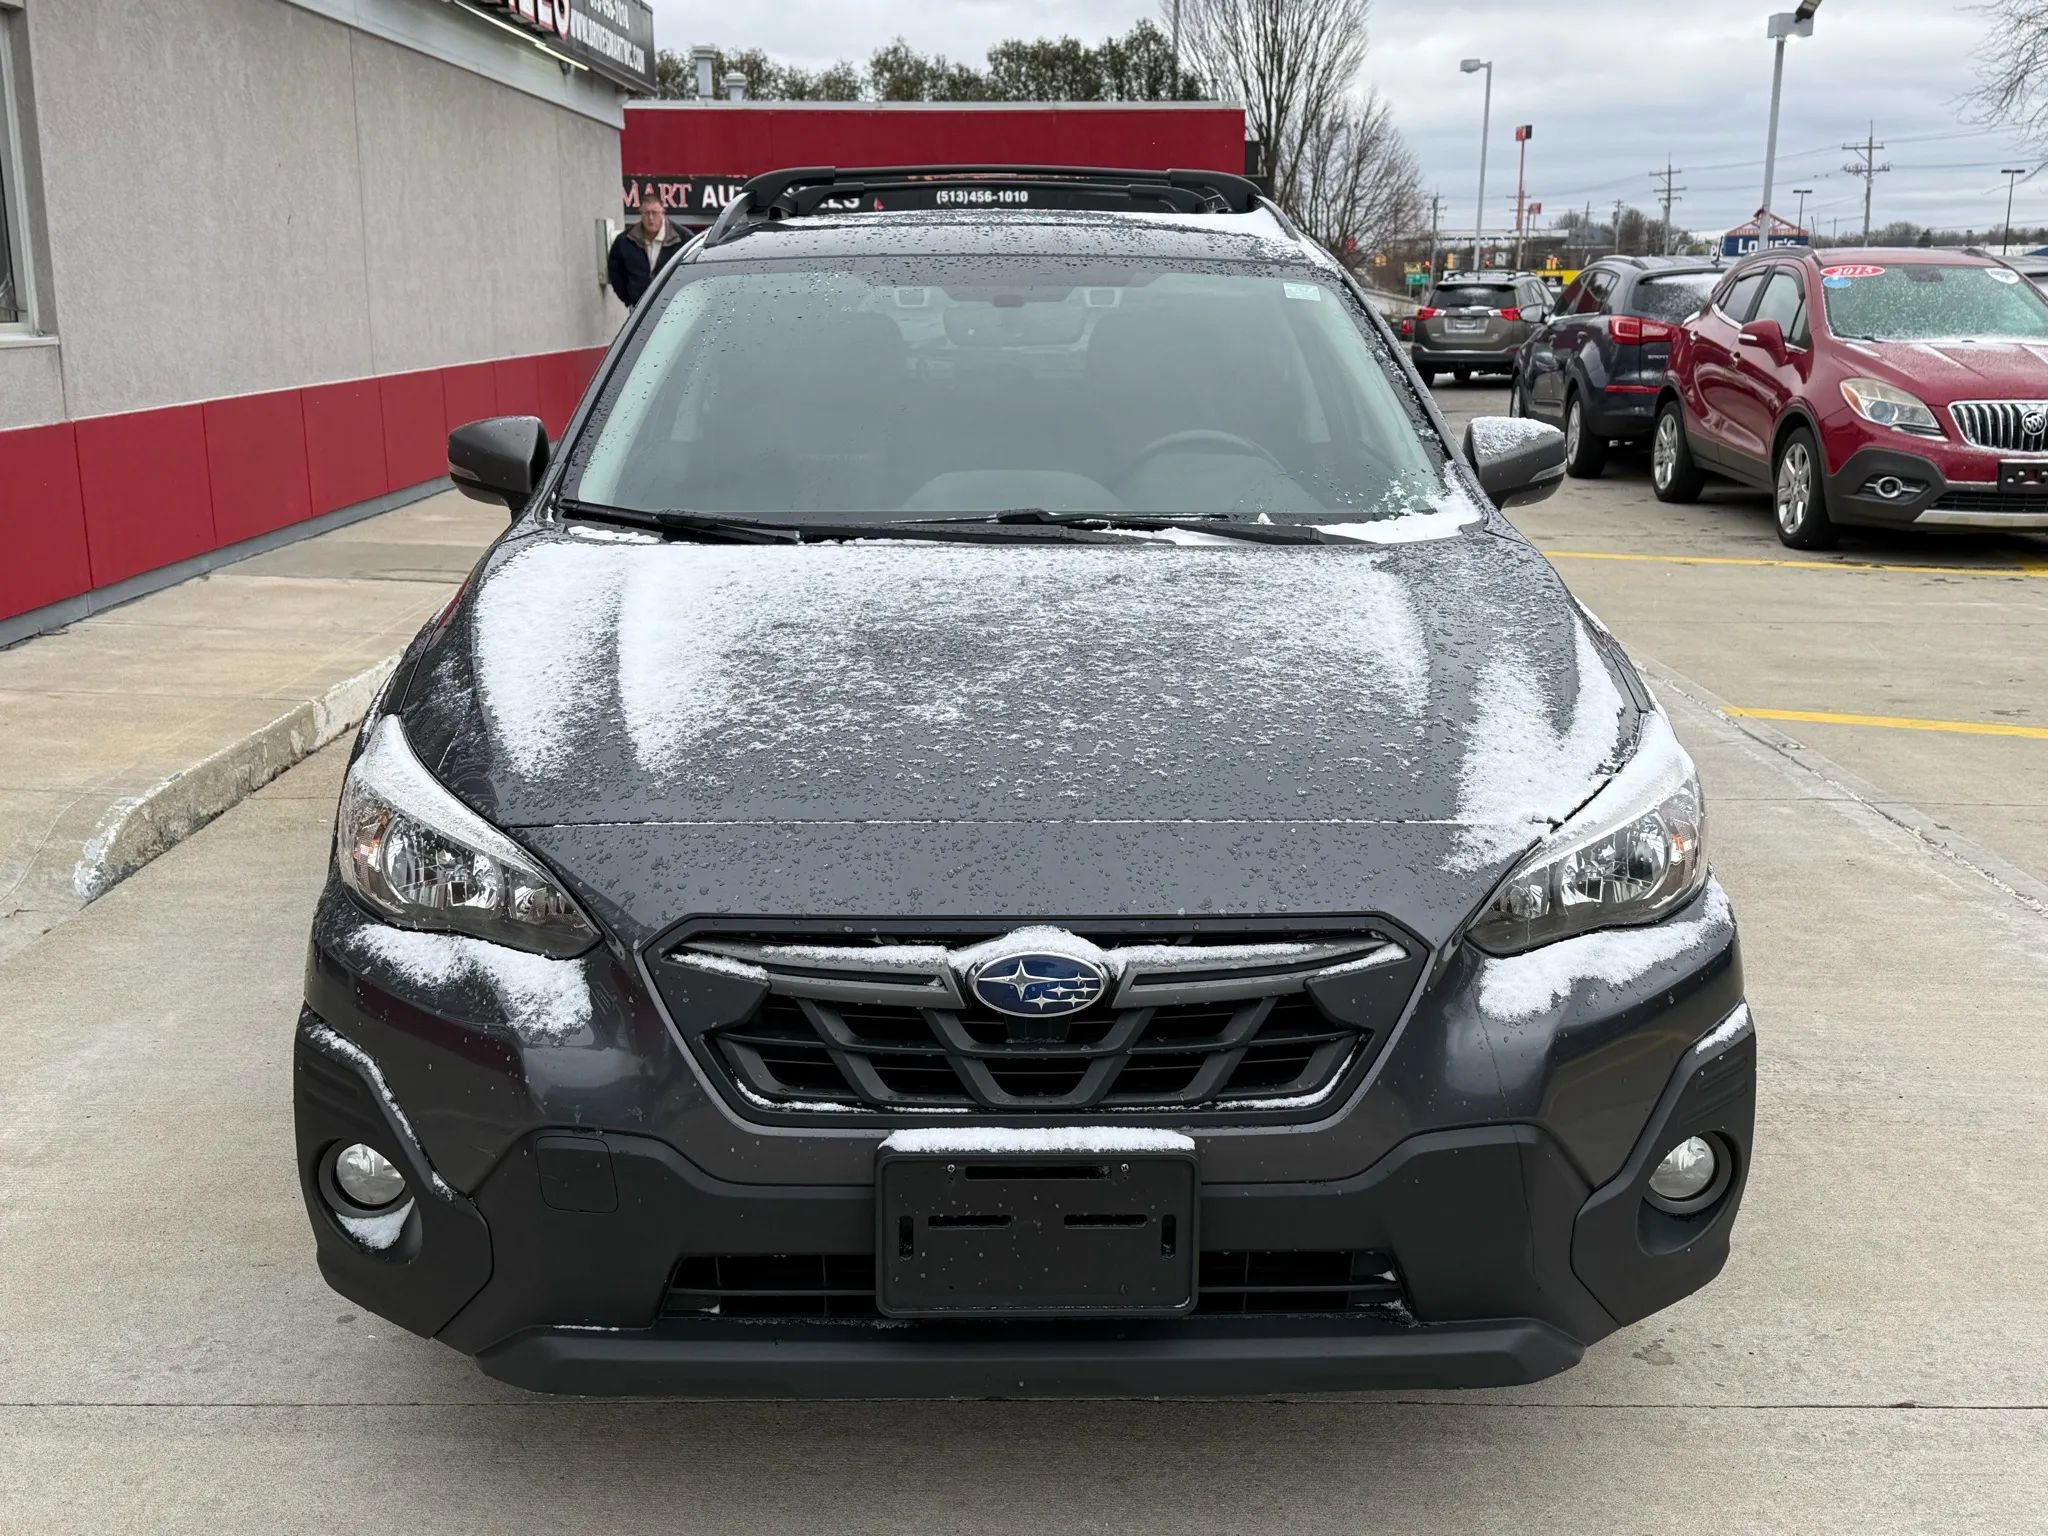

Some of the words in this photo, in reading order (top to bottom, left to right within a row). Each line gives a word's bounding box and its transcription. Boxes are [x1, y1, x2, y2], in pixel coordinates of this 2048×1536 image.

[702, 185, 744, 208] AU
[936, 190, 1029, 205] (513)456-1010
[1738, 238, 1796, 254] LOE'
